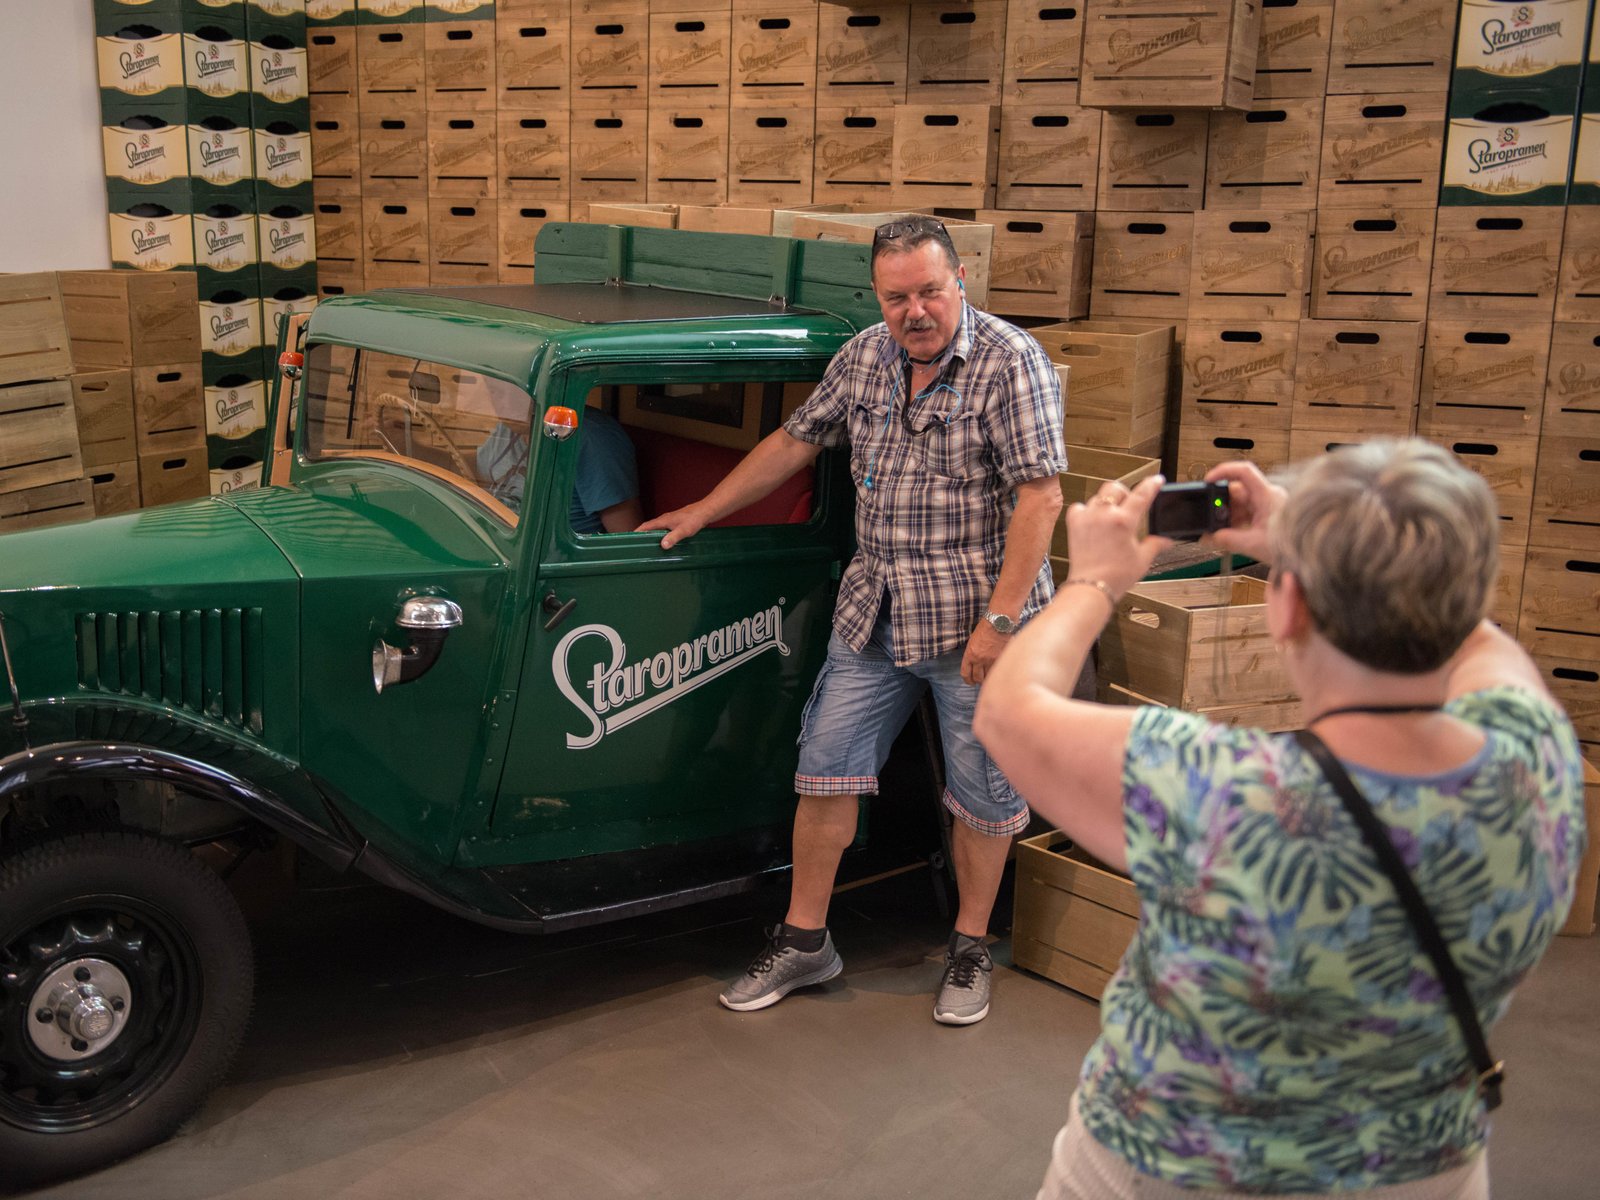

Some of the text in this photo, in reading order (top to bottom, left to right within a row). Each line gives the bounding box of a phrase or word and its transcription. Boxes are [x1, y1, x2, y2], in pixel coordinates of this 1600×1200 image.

[1481, 18, 1563, 55] Staropramen
[119, 51, 161, 79] Staropramen
[195, 50, 236, 78] Staropramen
[260, 59, 298, 85] Staropramen
[125, 142, 166, 169] Staropramen
[200, 141, 240, 168] Staropramen
[265, 145, 302, 171] Staropramen
[1468, 138, 1548, 174] Staropramen
[131, 229, 172, 255] Staropramen
[205, 229, 245, 255] Staropramen
[269, 229, 306, 255] Staropramen
[210, 315, 249, 341] Staropramen
[216, 398, 255, 424] Staropramen
[552, 603, 791, 750] Staropramen
